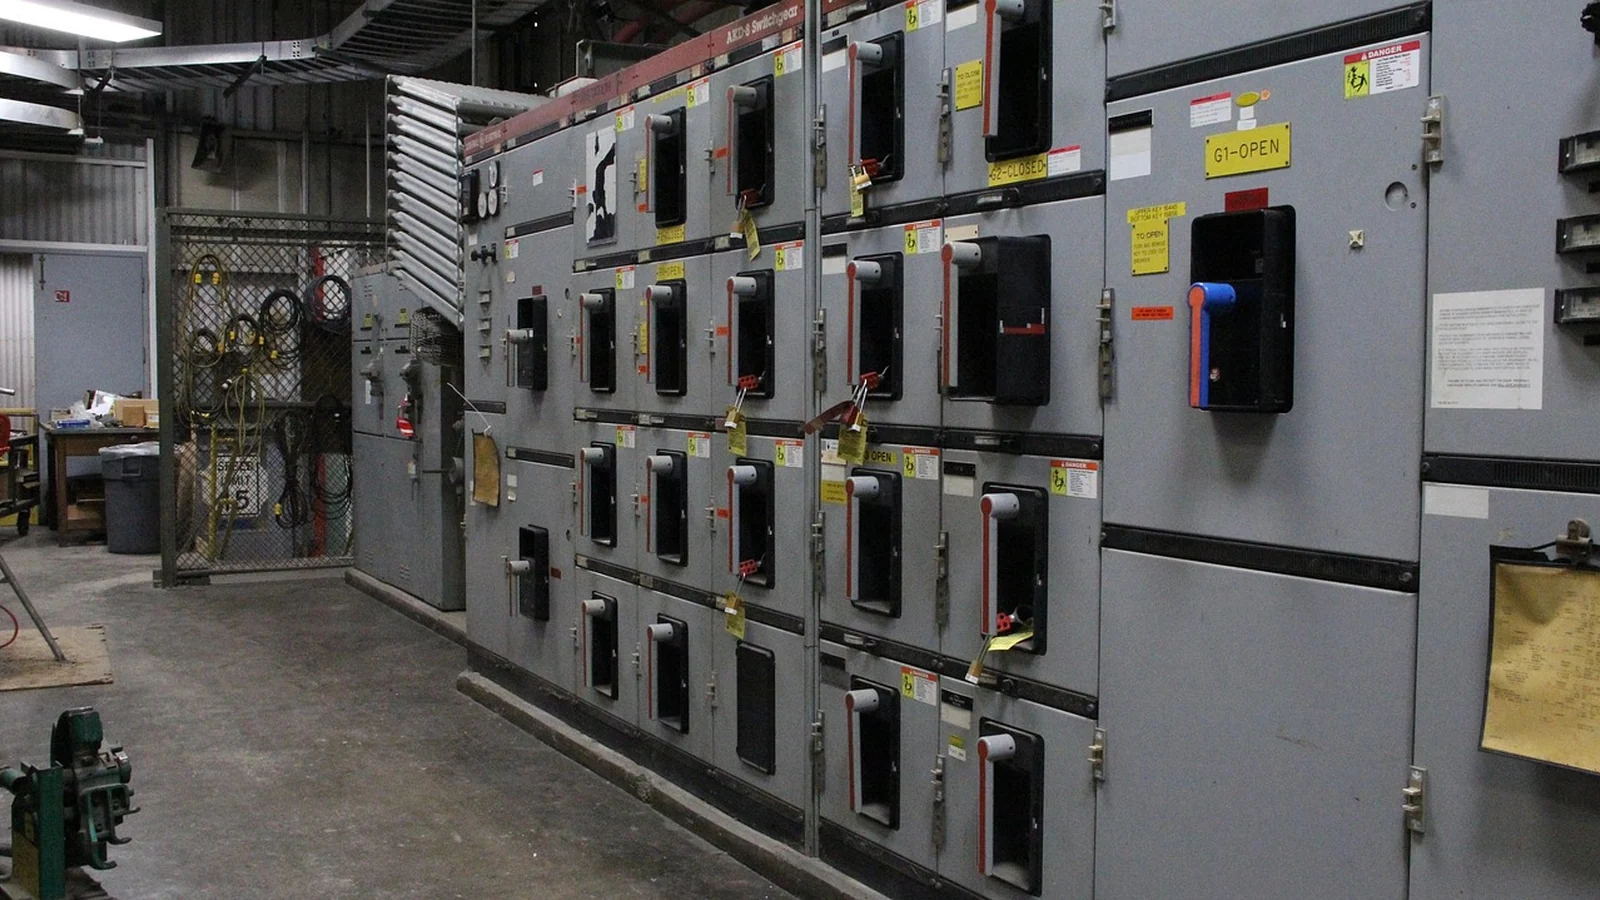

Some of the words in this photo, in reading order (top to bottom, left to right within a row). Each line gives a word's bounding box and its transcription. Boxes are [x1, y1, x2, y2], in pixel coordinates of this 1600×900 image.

[752, 5, 798, 33] Switchgear
[1367, 45, 1402, 59] DANGER
[1214, 138, 1279, 163] G1-OPEN
[990, 160, 1044, 181] G2-CLOSED
[1146, 230, 1164, 239] OPEN
[871, 450, 892, 463] OPEN
[1065, 461, 1088, 469] DANGER
